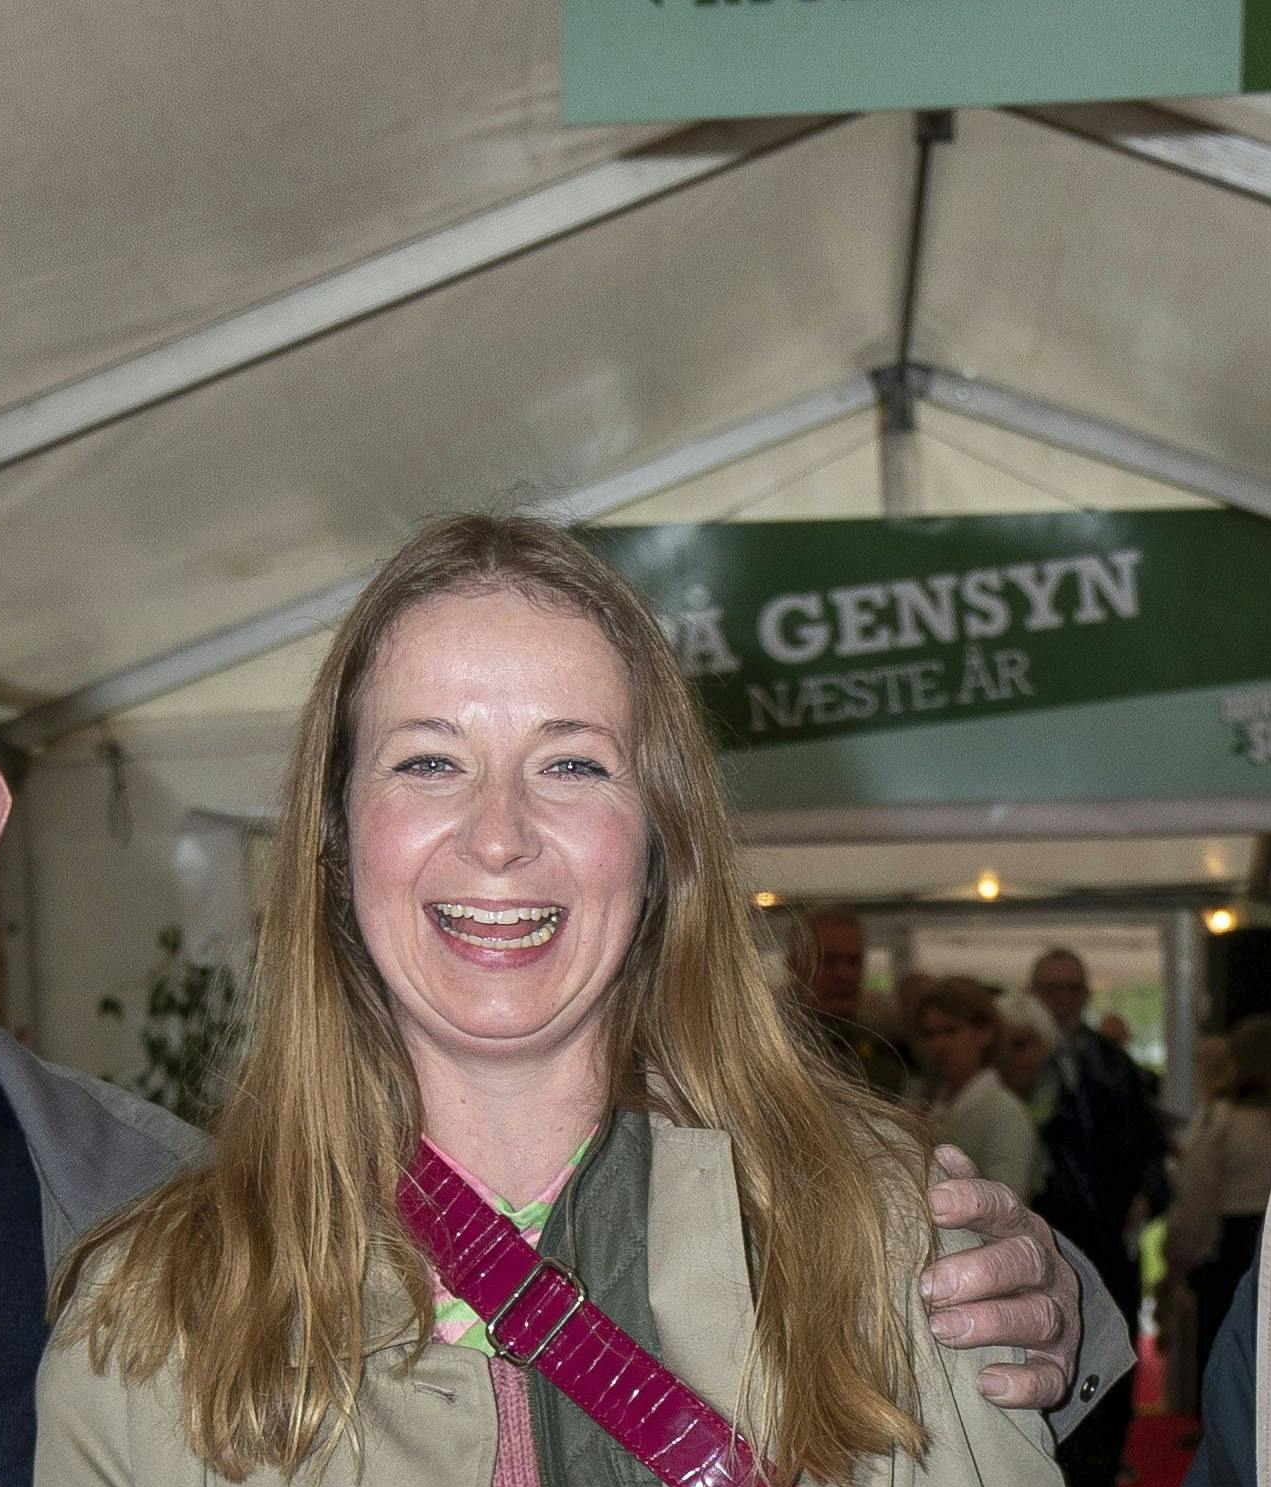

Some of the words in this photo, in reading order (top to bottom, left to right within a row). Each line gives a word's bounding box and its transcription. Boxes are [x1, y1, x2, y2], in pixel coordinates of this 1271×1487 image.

[756, 548, 1143, 665] GENSYN
[746, 660, 949, 733] NÆSTE
[956, 643, 1034, 704] ÅR
